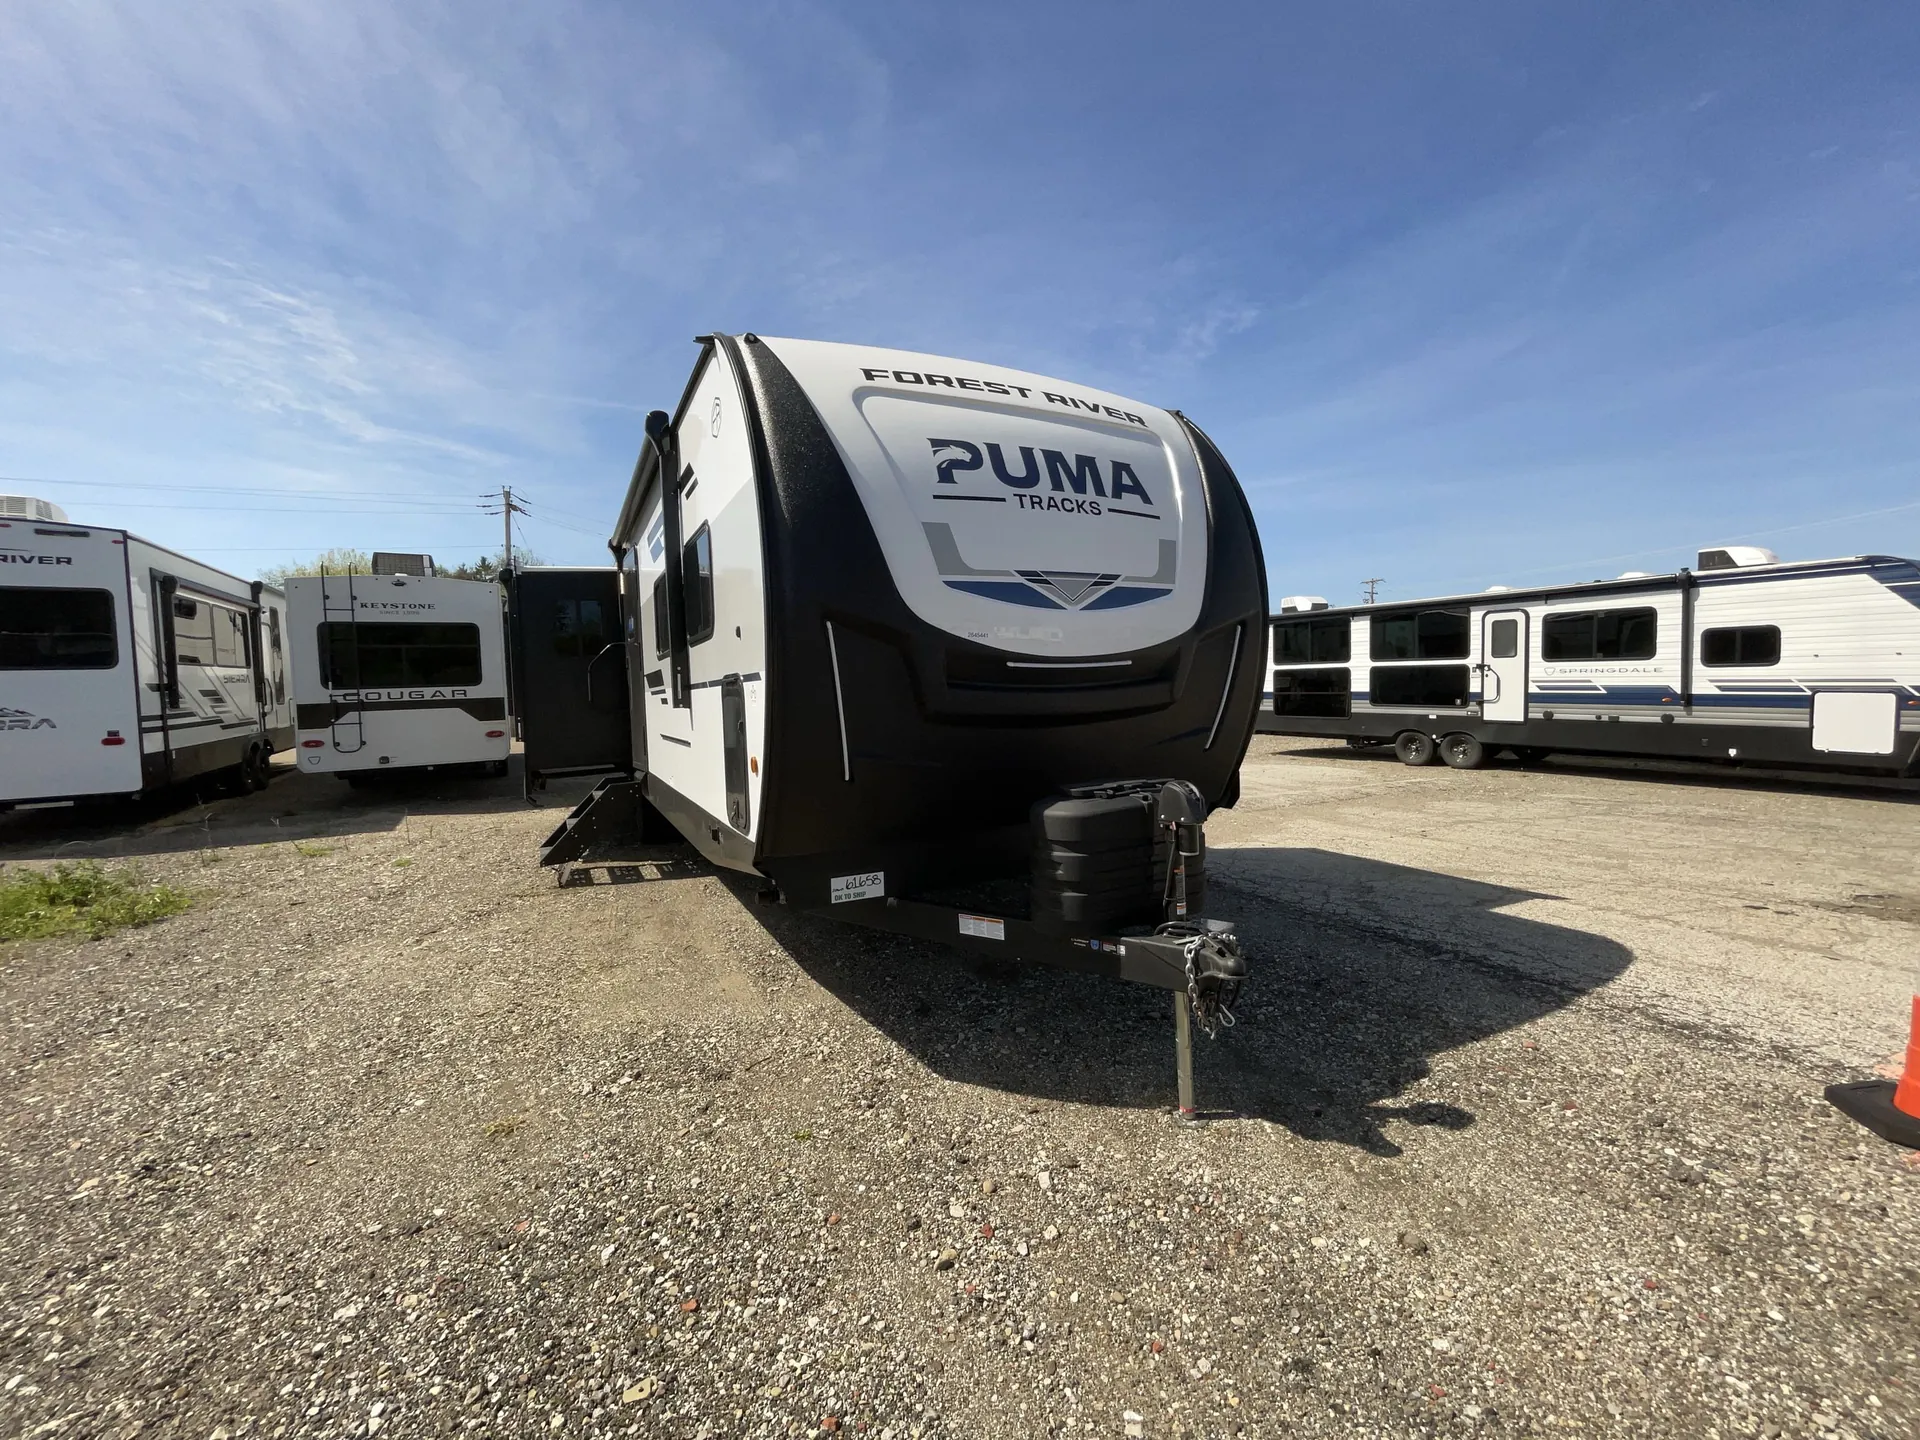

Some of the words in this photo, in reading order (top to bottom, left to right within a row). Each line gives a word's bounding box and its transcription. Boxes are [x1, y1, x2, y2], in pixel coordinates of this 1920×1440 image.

[859, 367, 1032, 399] FOREST
[1041, 390, 1149, 428] RIVER
[926, 437, 1154, 506] PUMA
[1012, 492, 1103, 516] TRACKS
[360, 602, 436, 610] KEYSTONE
[223, 674, 251, 684] SIERRA
[342, 689, 468, 702] COUGAR
[845, 873, 882, 890] 61658
[834, 894, 844, 902] OK
[844, 892, 852, 900] TO
[852, 890, 867, 899] SHIP
